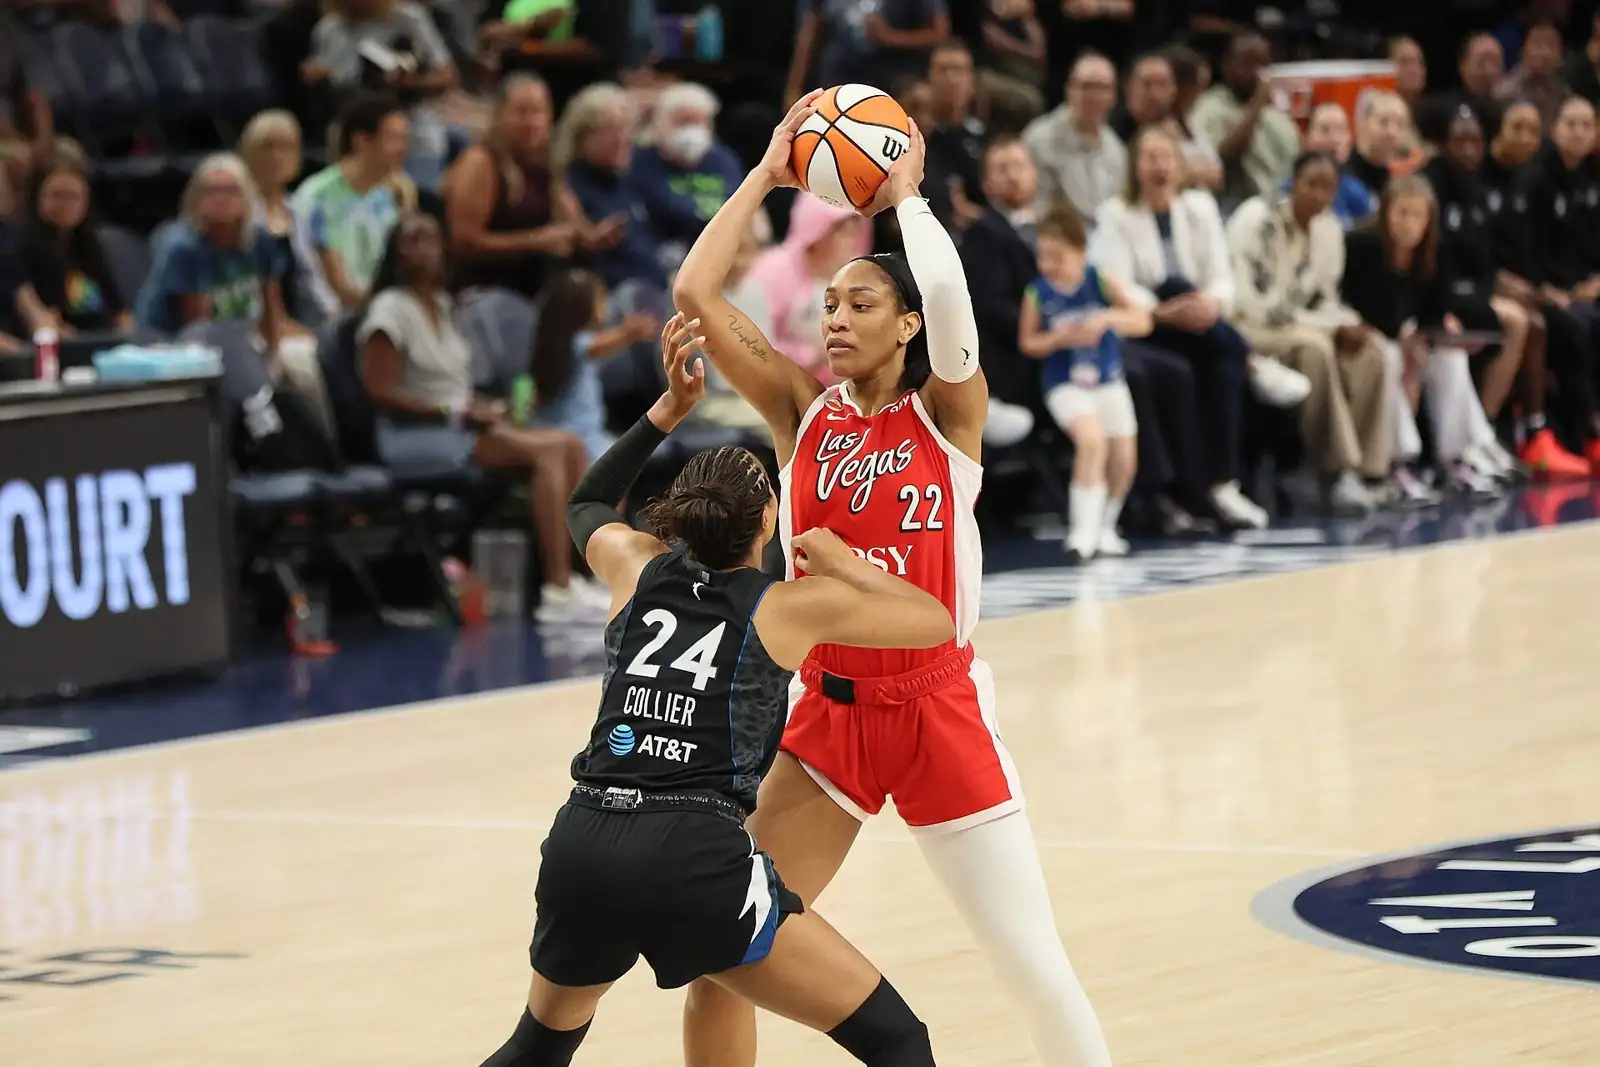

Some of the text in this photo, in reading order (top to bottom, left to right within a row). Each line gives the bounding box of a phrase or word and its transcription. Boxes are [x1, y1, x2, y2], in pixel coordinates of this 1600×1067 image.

[816, 429, 860, 461] Las
[816, 428, 917, 512] Vegas
[899, 483, 944, 531] 22
[0, 461, 197, 628] OURT
[625, 608, 727, 691] 24
[623, 685, 697, 727] COLLIER
[637, 734, 698, 763] AT&T
